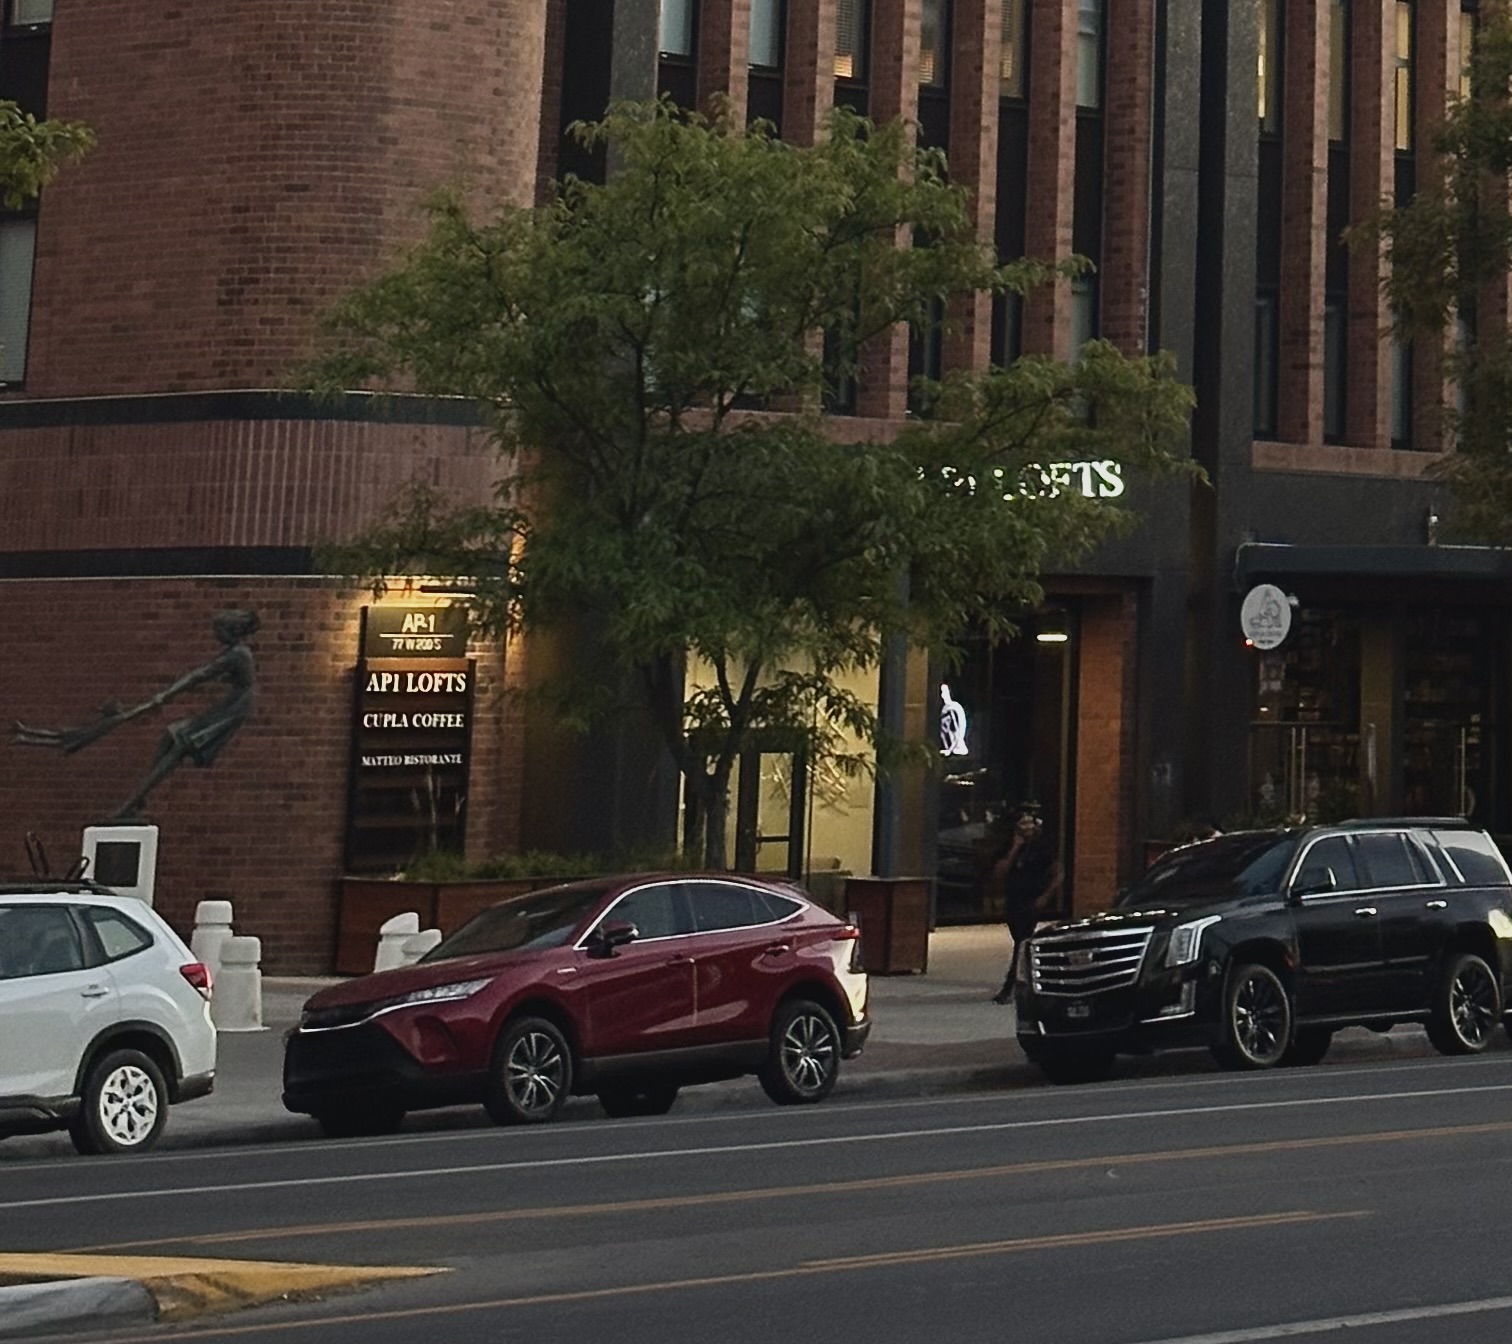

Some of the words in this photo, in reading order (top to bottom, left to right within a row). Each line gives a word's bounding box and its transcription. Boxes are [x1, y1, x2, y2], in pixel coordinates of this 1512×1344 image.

[434, 638, 442, 650] S
[406, 672, 467, 693] LOFTS
[363, 713, 409, 728] CUPLA
[412, 713, 465, 728] COFFEE
[362, 755, 402, 766] MATTEO
[404, 754, 463, 765] RISTORANTE
